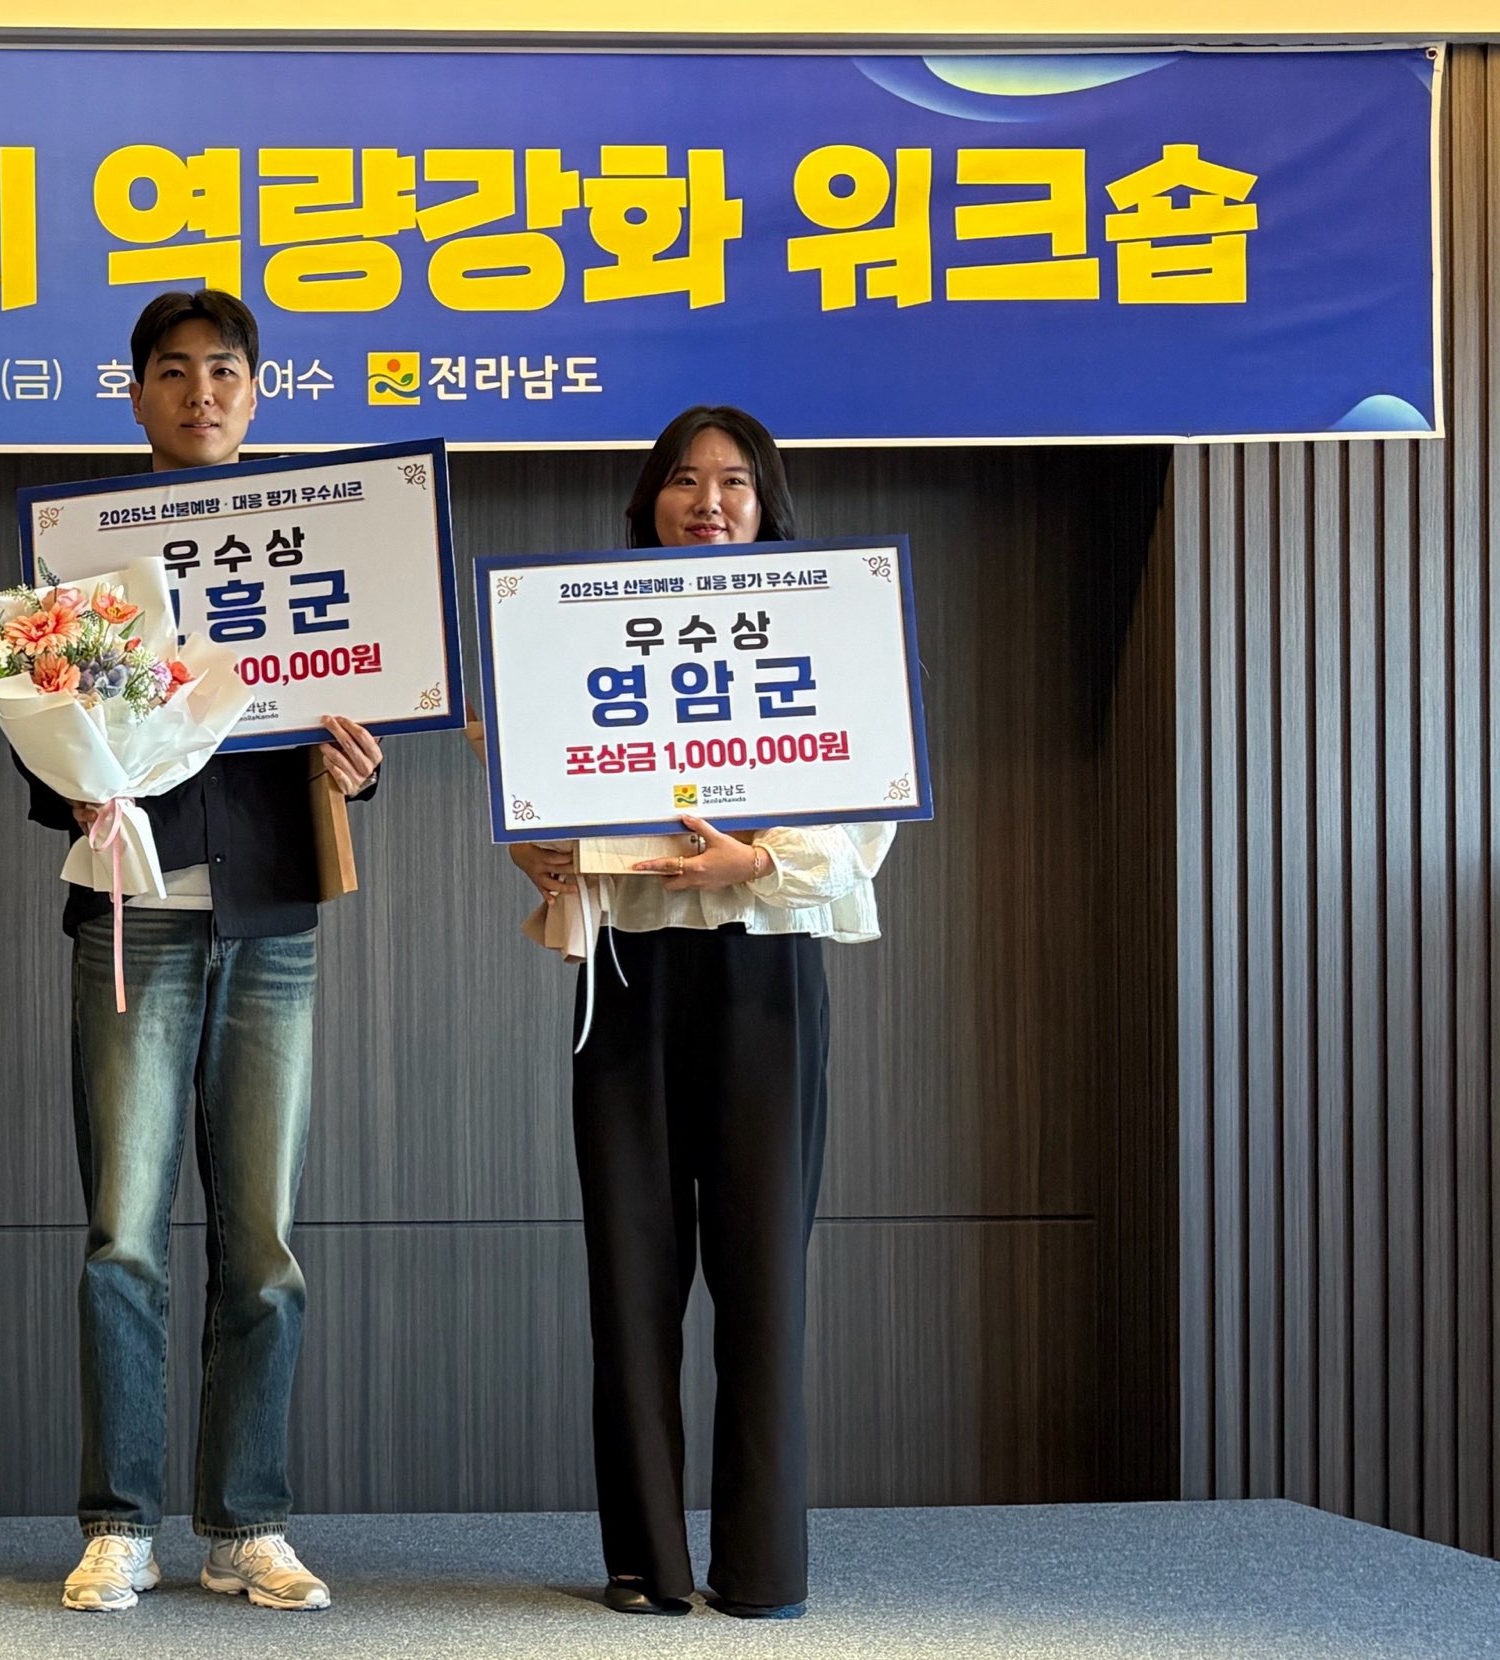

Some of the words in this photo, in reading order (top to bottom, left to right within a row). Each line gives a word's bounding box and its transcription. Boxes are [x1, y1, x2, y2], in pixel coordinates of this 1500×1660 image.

[93, 144, 743, 312] 역량강화
[787, 143, 1258, 311] 워크숍
[96, 359, 133, 399] 호
[258, 359, 335, 401] 여수
[427, 355, 603, 400] 전라남도
[99, 508, 157, 526] 2025년
[161, 498, 221, 518] 산불예방
[232, 493, 263, 511] 대응
[266, 488, 297, 507] 평가
[301, 481, 363, 501] 우수시군
[560, 580, 619, 598] 2025년
[623, 577, 684, 595] 산불예방
[696, 574, 728, 591] 대응
[731, 571, 762, 589] 평가
[766, 569, 828, 587] 우수시군
[169, 569, 350, 645] 흥군
[233, 643, 382, 686] 00,000원
[565, 741, 657, 776] 포상금
[663, 730, 851, 775] 1,000,000원
[701, 784, 746, 797] 전라남도
